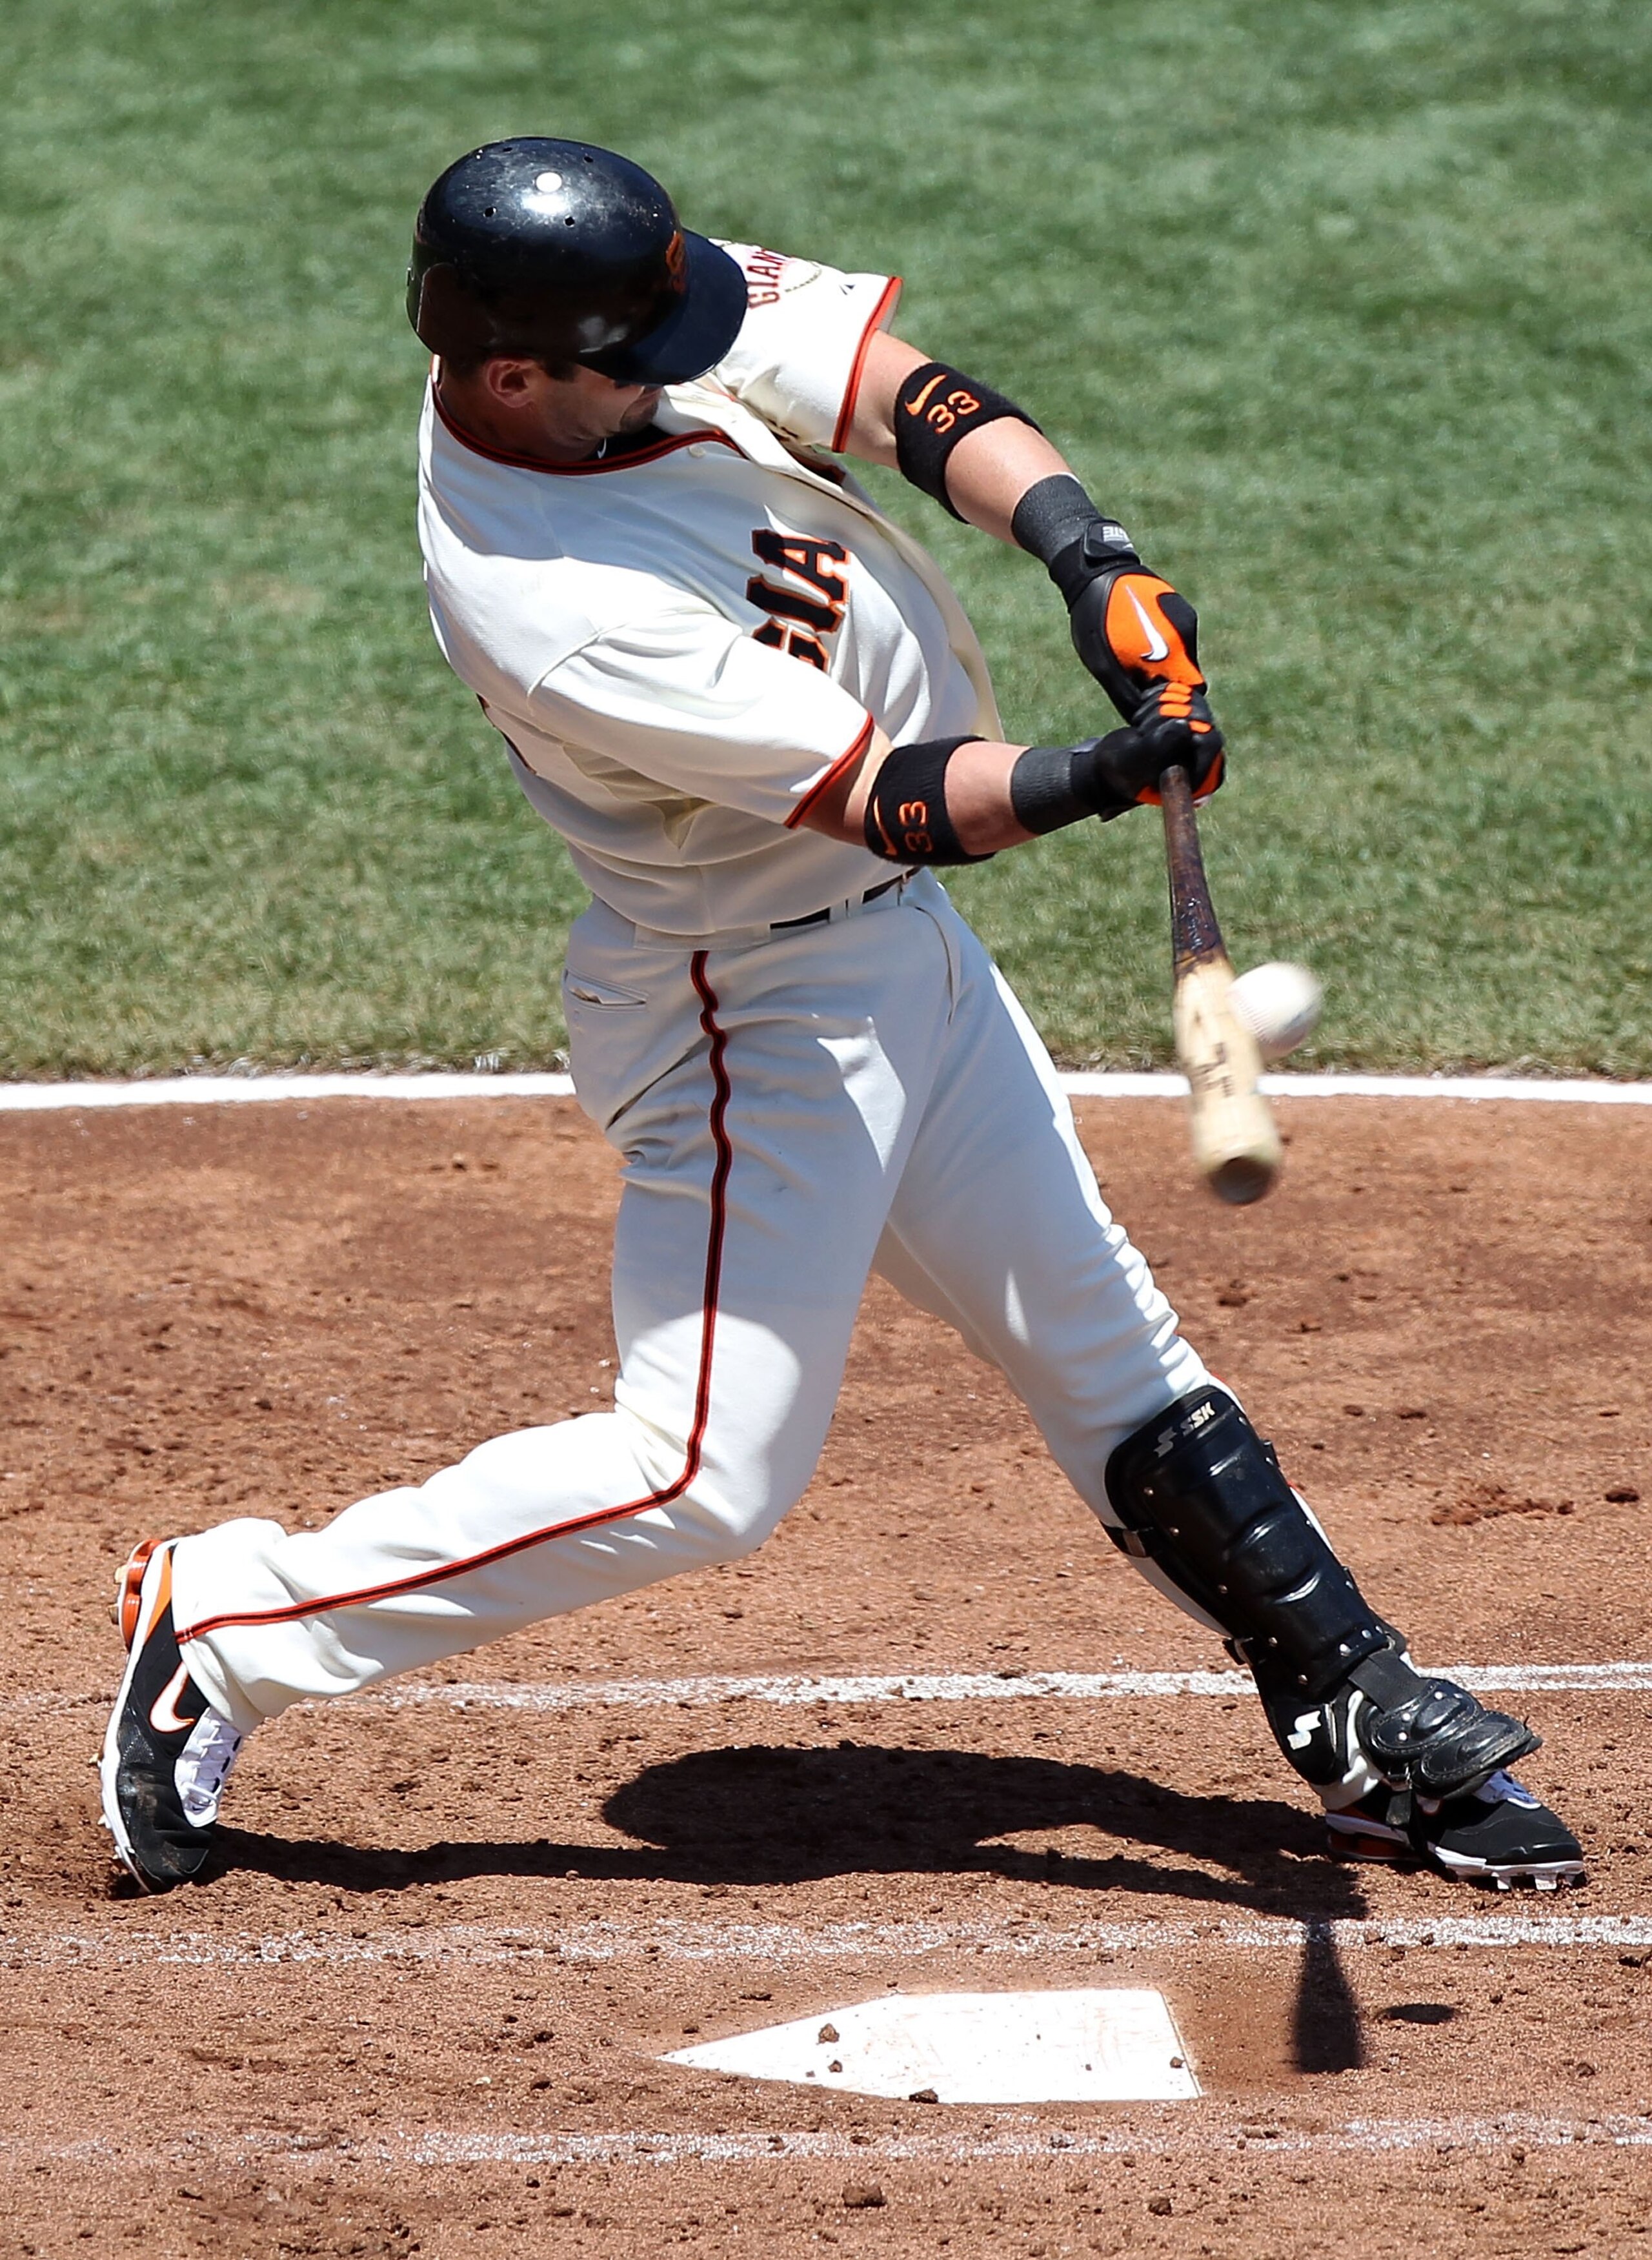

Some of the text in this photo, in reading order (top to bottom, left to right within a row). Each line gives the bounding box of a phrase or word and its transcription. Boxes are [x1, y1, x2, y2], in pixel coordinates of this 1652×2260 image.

[927, 390, 981, 433] 33
[898, 800, 933, 853] 33
[1180, 1400, 1215, 1437] SSK
